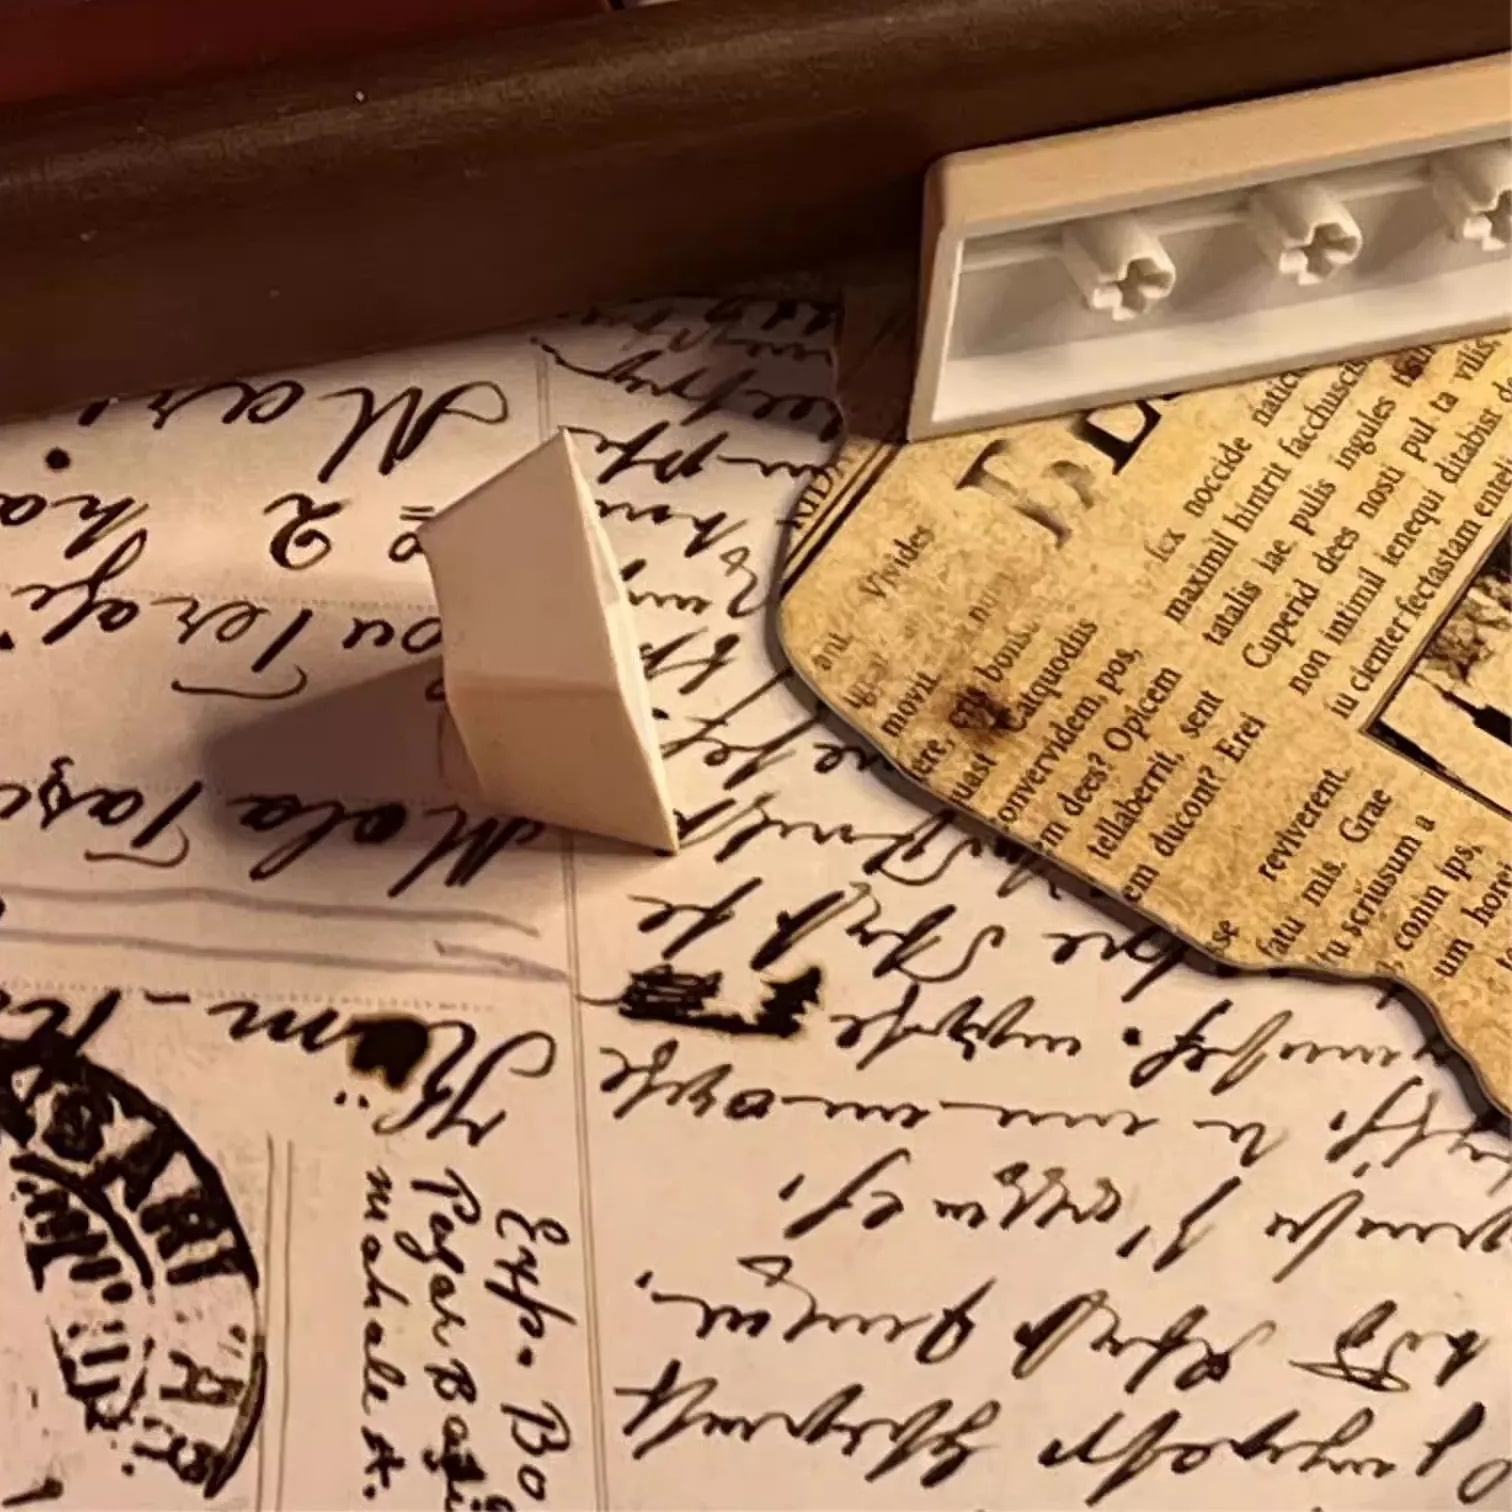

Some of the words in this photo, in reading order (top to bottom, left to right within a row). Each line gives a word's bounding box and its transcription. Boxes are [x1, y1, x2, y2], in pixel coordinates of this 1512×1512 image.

[1182, 436, 1252, 518] noccide
[261, 491, 344, 571] 2
[1163, 529, 1238, 624] maximil
[1221, 461, 1292, 533] hintrit
[1201, 580, 1262, 646] tatalis
[1287, 478, 1337, 537] pulis
[1334, 395, 1397, 471] ingules
[1241, 577, 1320, 669] Cuperid
[1310, 525, 1360, 575] dees
[1355, 464, 1406, 520] nosti
[1399, 415, 1438, 463] pul
[1427, 390, 1460, 414] ta
[1287, 648, 1332, 696] non
[1320, 565, 1386, 645] intimil
[1373, 488, 1445, 568] ienequi
[1178, 689, 1224, 739] sent
[1056, 751, 1114, 817] dees?
[1148, 764, 1224, 857] ducont?
[1337, 788, 1393, 844] Grae
[1413, 813, 1436, 833] a
[1392, 884, 1449, 952] conin
[1434, 844, 1483, 882] ips,
[1432, 937, 1475, 978] um
